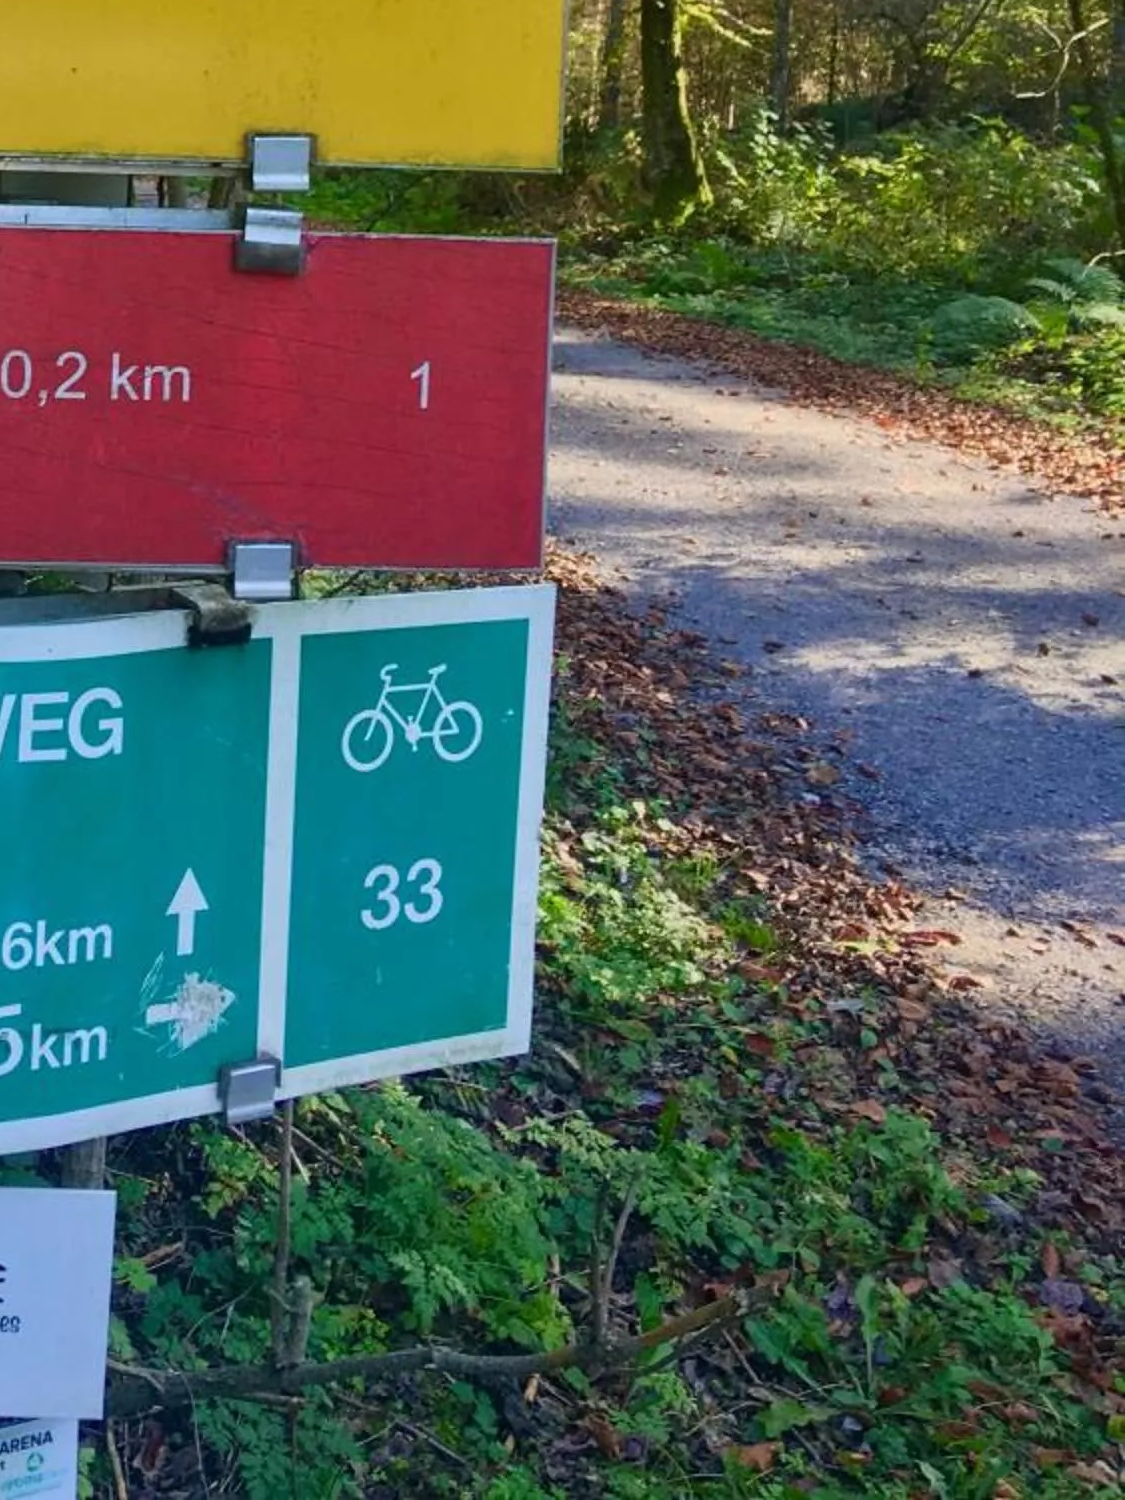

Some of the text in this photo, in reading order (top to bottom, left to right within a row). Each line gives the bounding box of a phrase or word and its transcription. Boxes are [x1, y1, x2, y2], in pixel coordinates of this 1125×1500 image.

[109, 353, 191, 403] km
[410, 361, 432, 409] 1
[361, 858, 444, 930] 33
